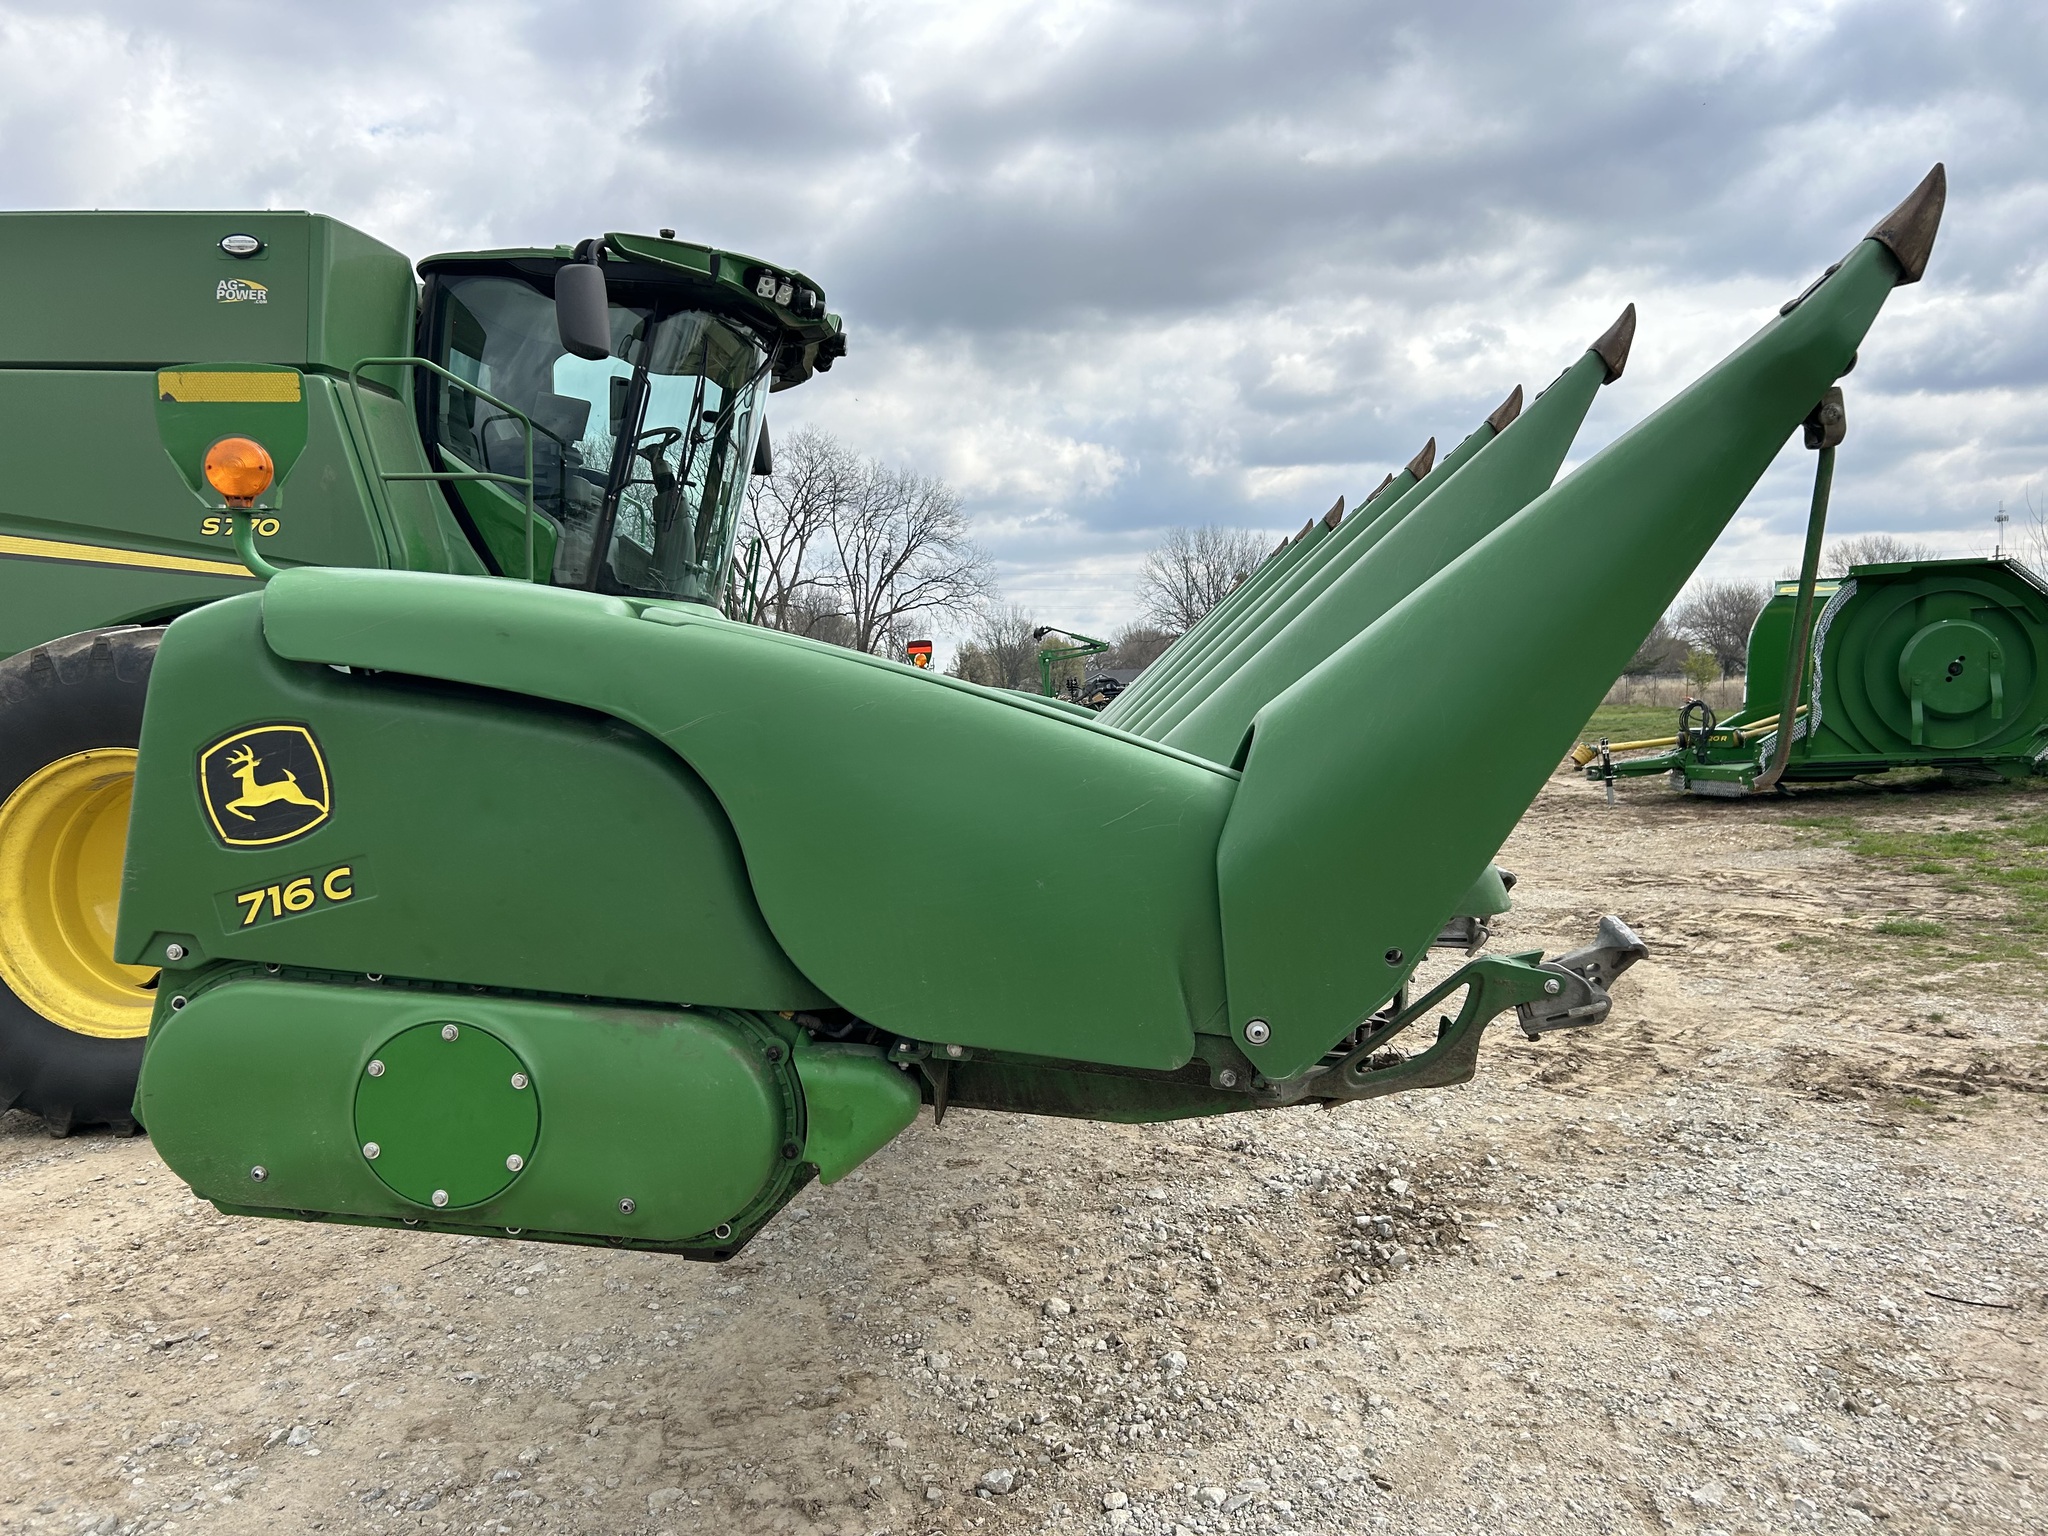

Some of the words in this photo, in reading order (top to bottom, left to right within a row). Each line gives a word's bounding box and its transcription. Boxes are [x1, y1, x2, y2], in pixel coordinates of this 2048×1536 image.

[217, 279, 245, 290] AG-
[216, 289, 267, 300] POWER
[237, 876, 316, 926] 716
[322, 866, 353, 901] C
